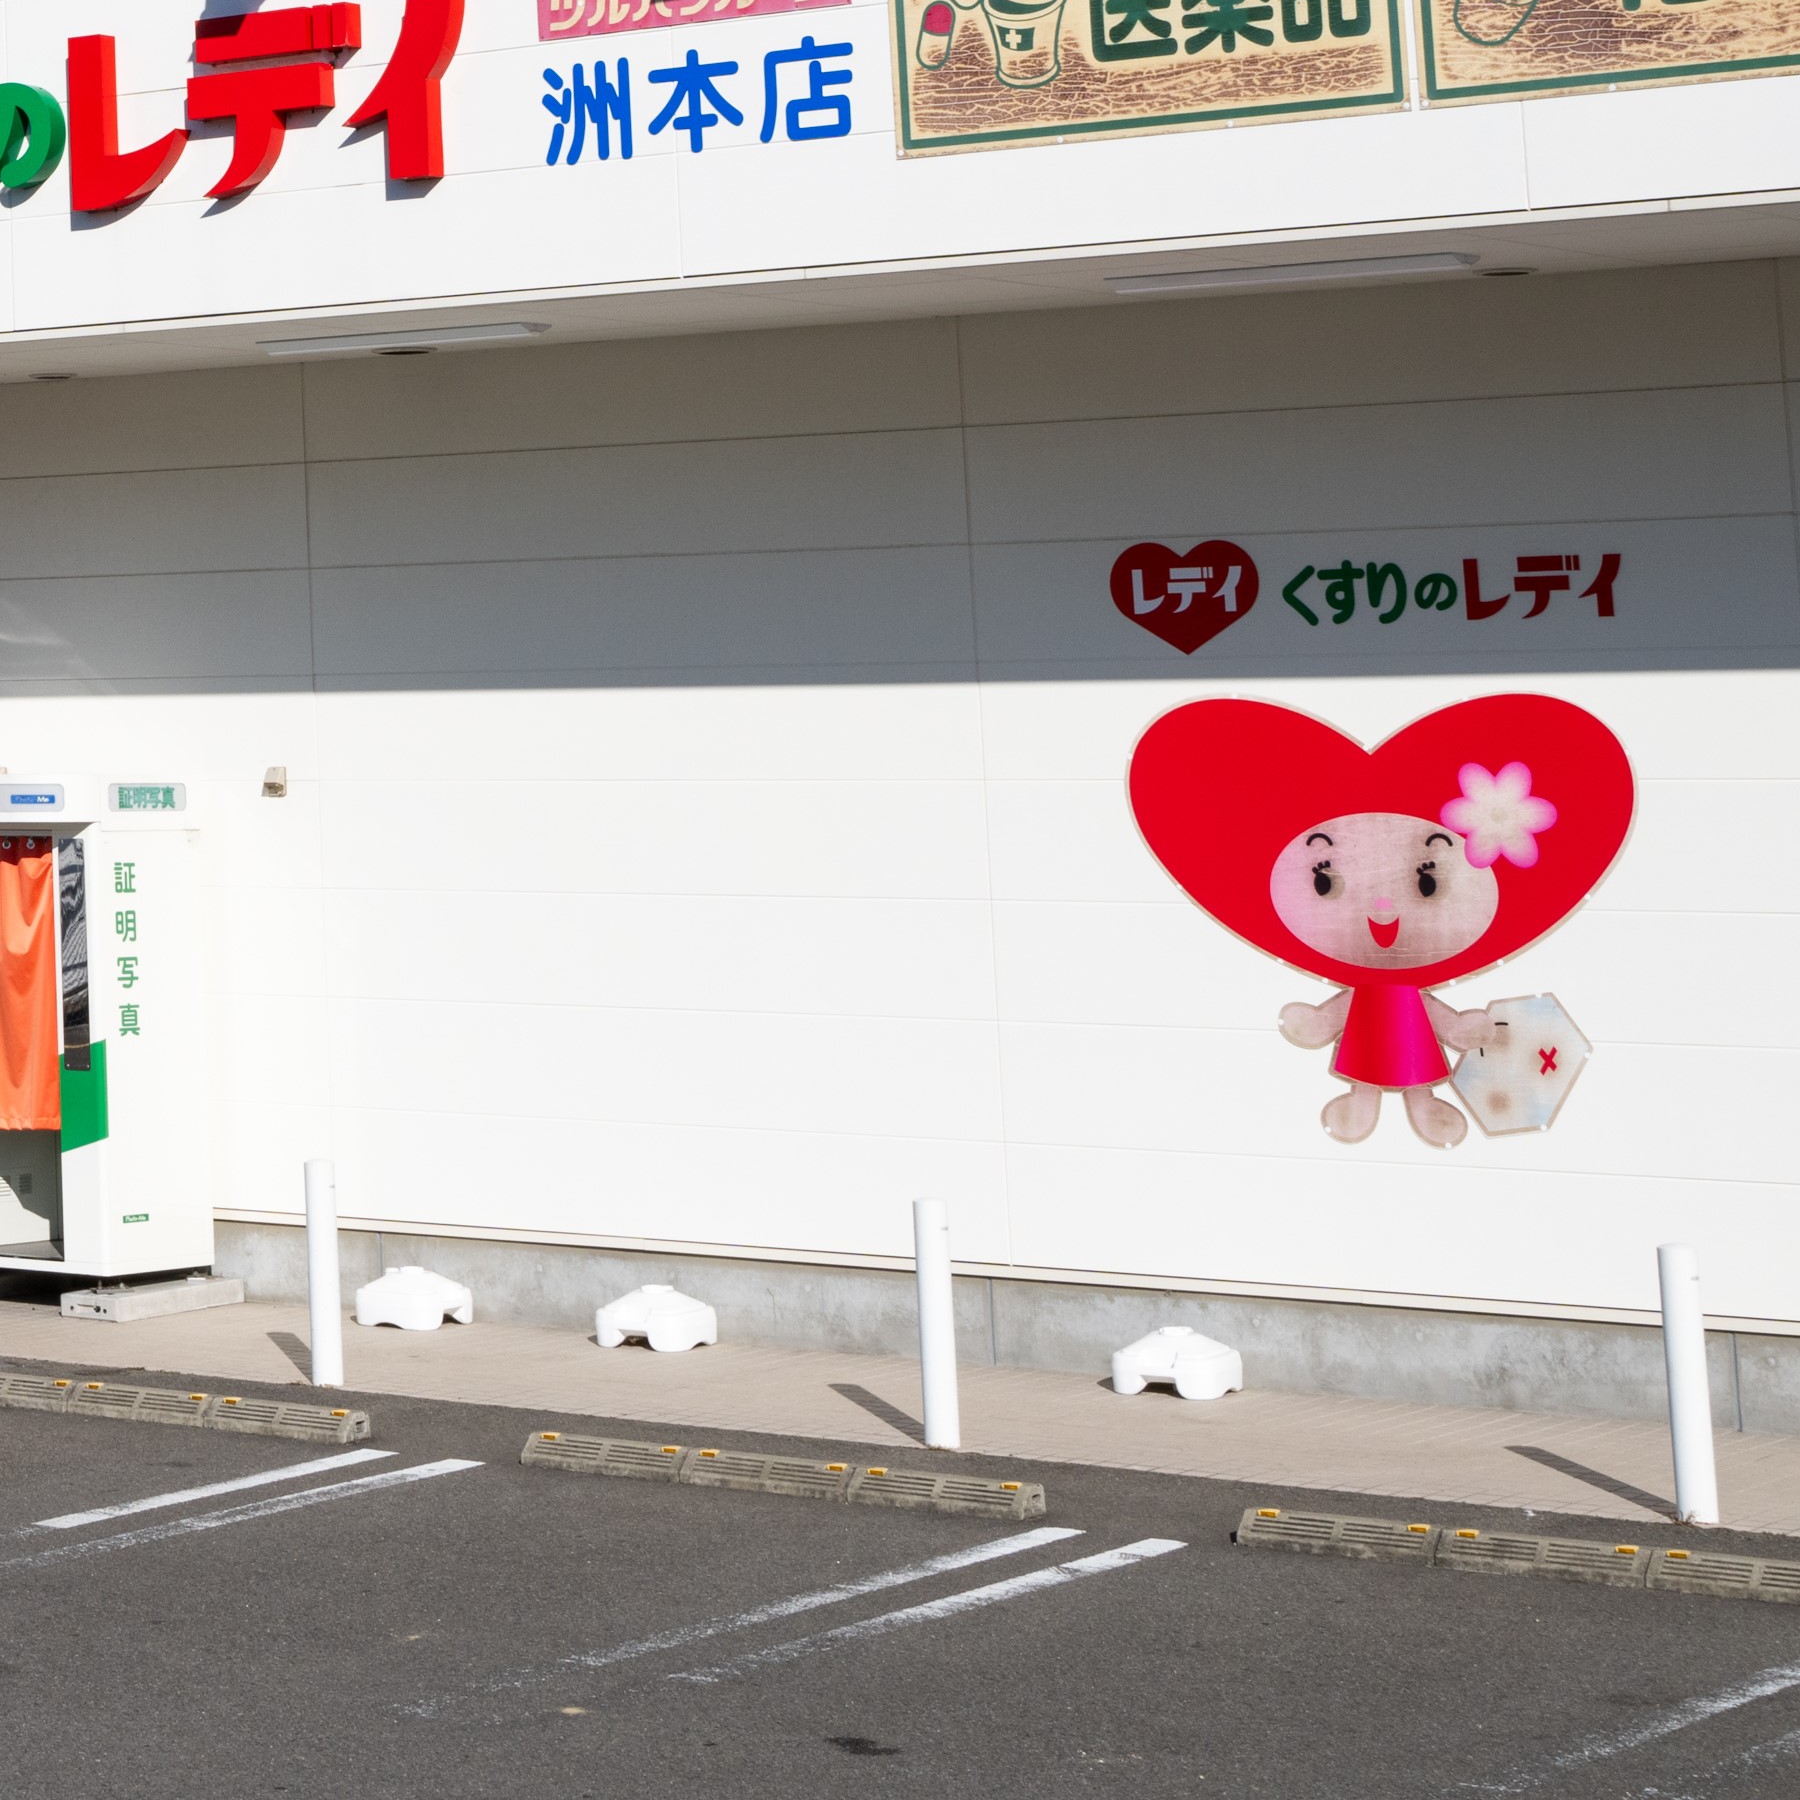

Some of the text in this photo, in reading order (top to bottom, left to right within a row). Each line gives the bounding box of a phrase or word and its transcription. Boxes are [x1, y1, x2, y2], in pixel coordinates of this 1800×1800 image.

[541, 36, 854, 166] 洲本店
[1130, 564, 1243, 615] レディ
[1282, 552, 1623, 626] くすりのレディ
[117, 786, 176, 809] 証明写真
[113, 861, 141, 1037] 証明写真
